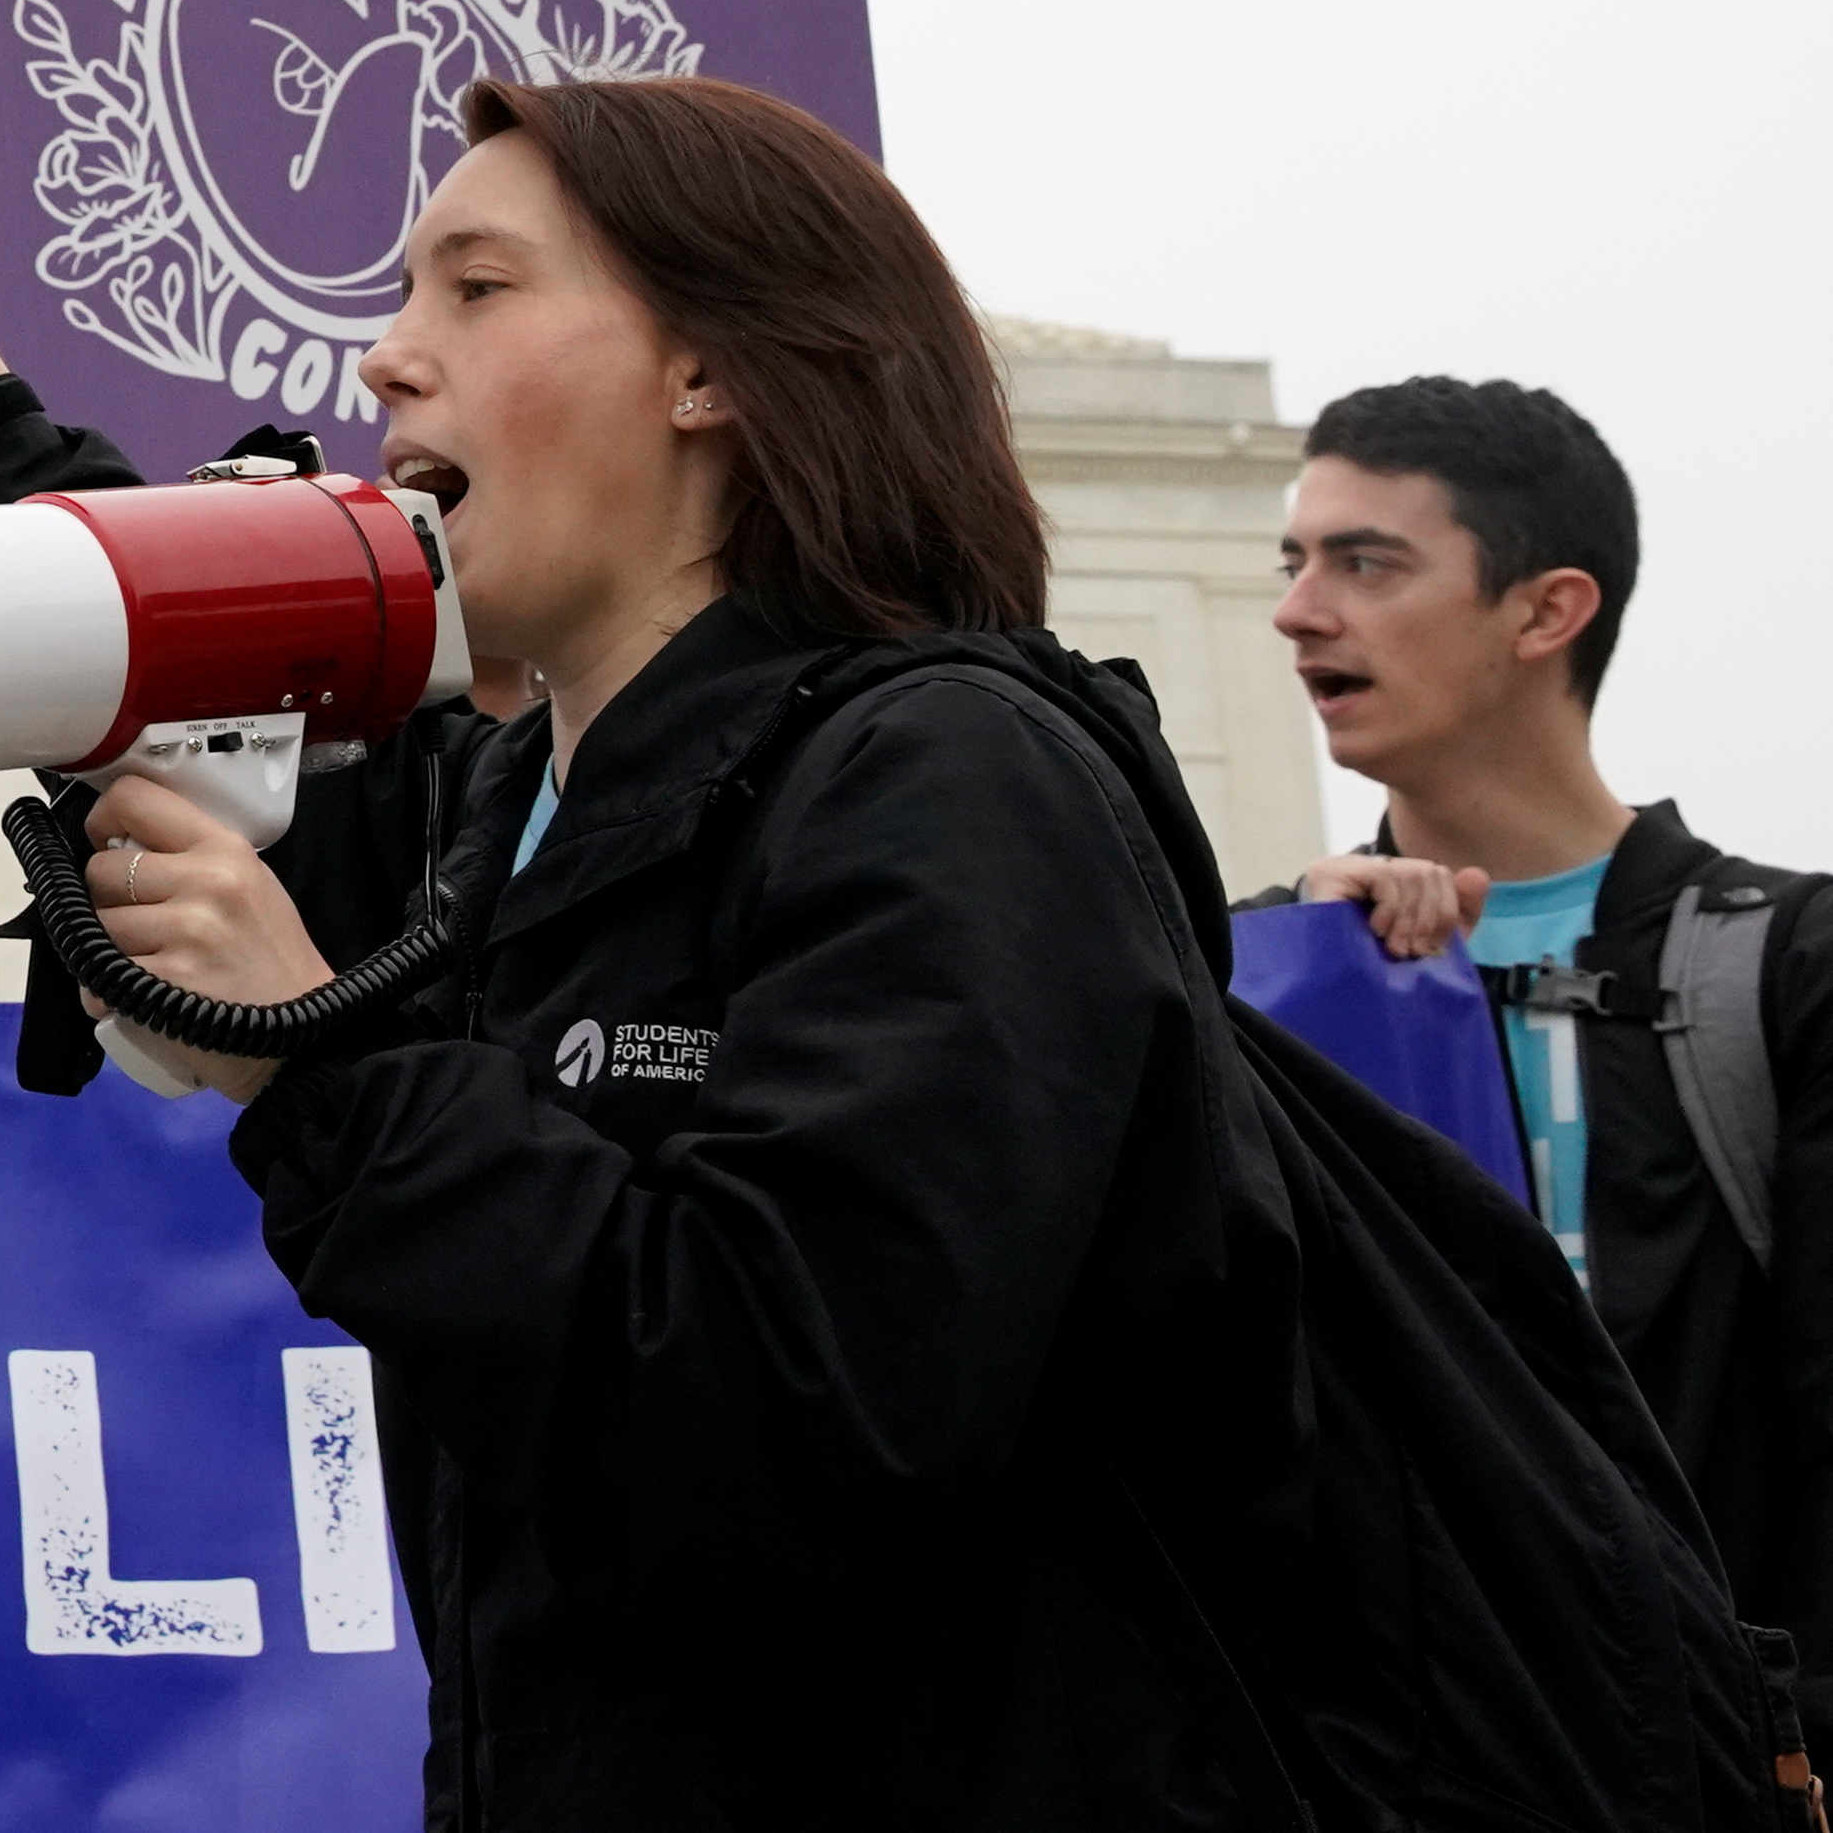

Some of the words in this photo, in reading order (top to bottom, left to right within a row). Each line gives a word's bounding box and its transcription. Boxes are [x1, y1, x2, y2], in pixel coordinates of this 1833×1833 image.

[229, 318, 379, 424] CON
[235, 720, 256, 730] TALK
[614, 1023, 721, 1048] STUDENTS
[612, 1042, 653, 1062] FOR
[658, 1044, 710, 1067] LIFE
[610, 1063, 630, 1078] OF
[633, 1064, 707, 1083] AMERIC
[6, 1345, 397, 1659] LI
